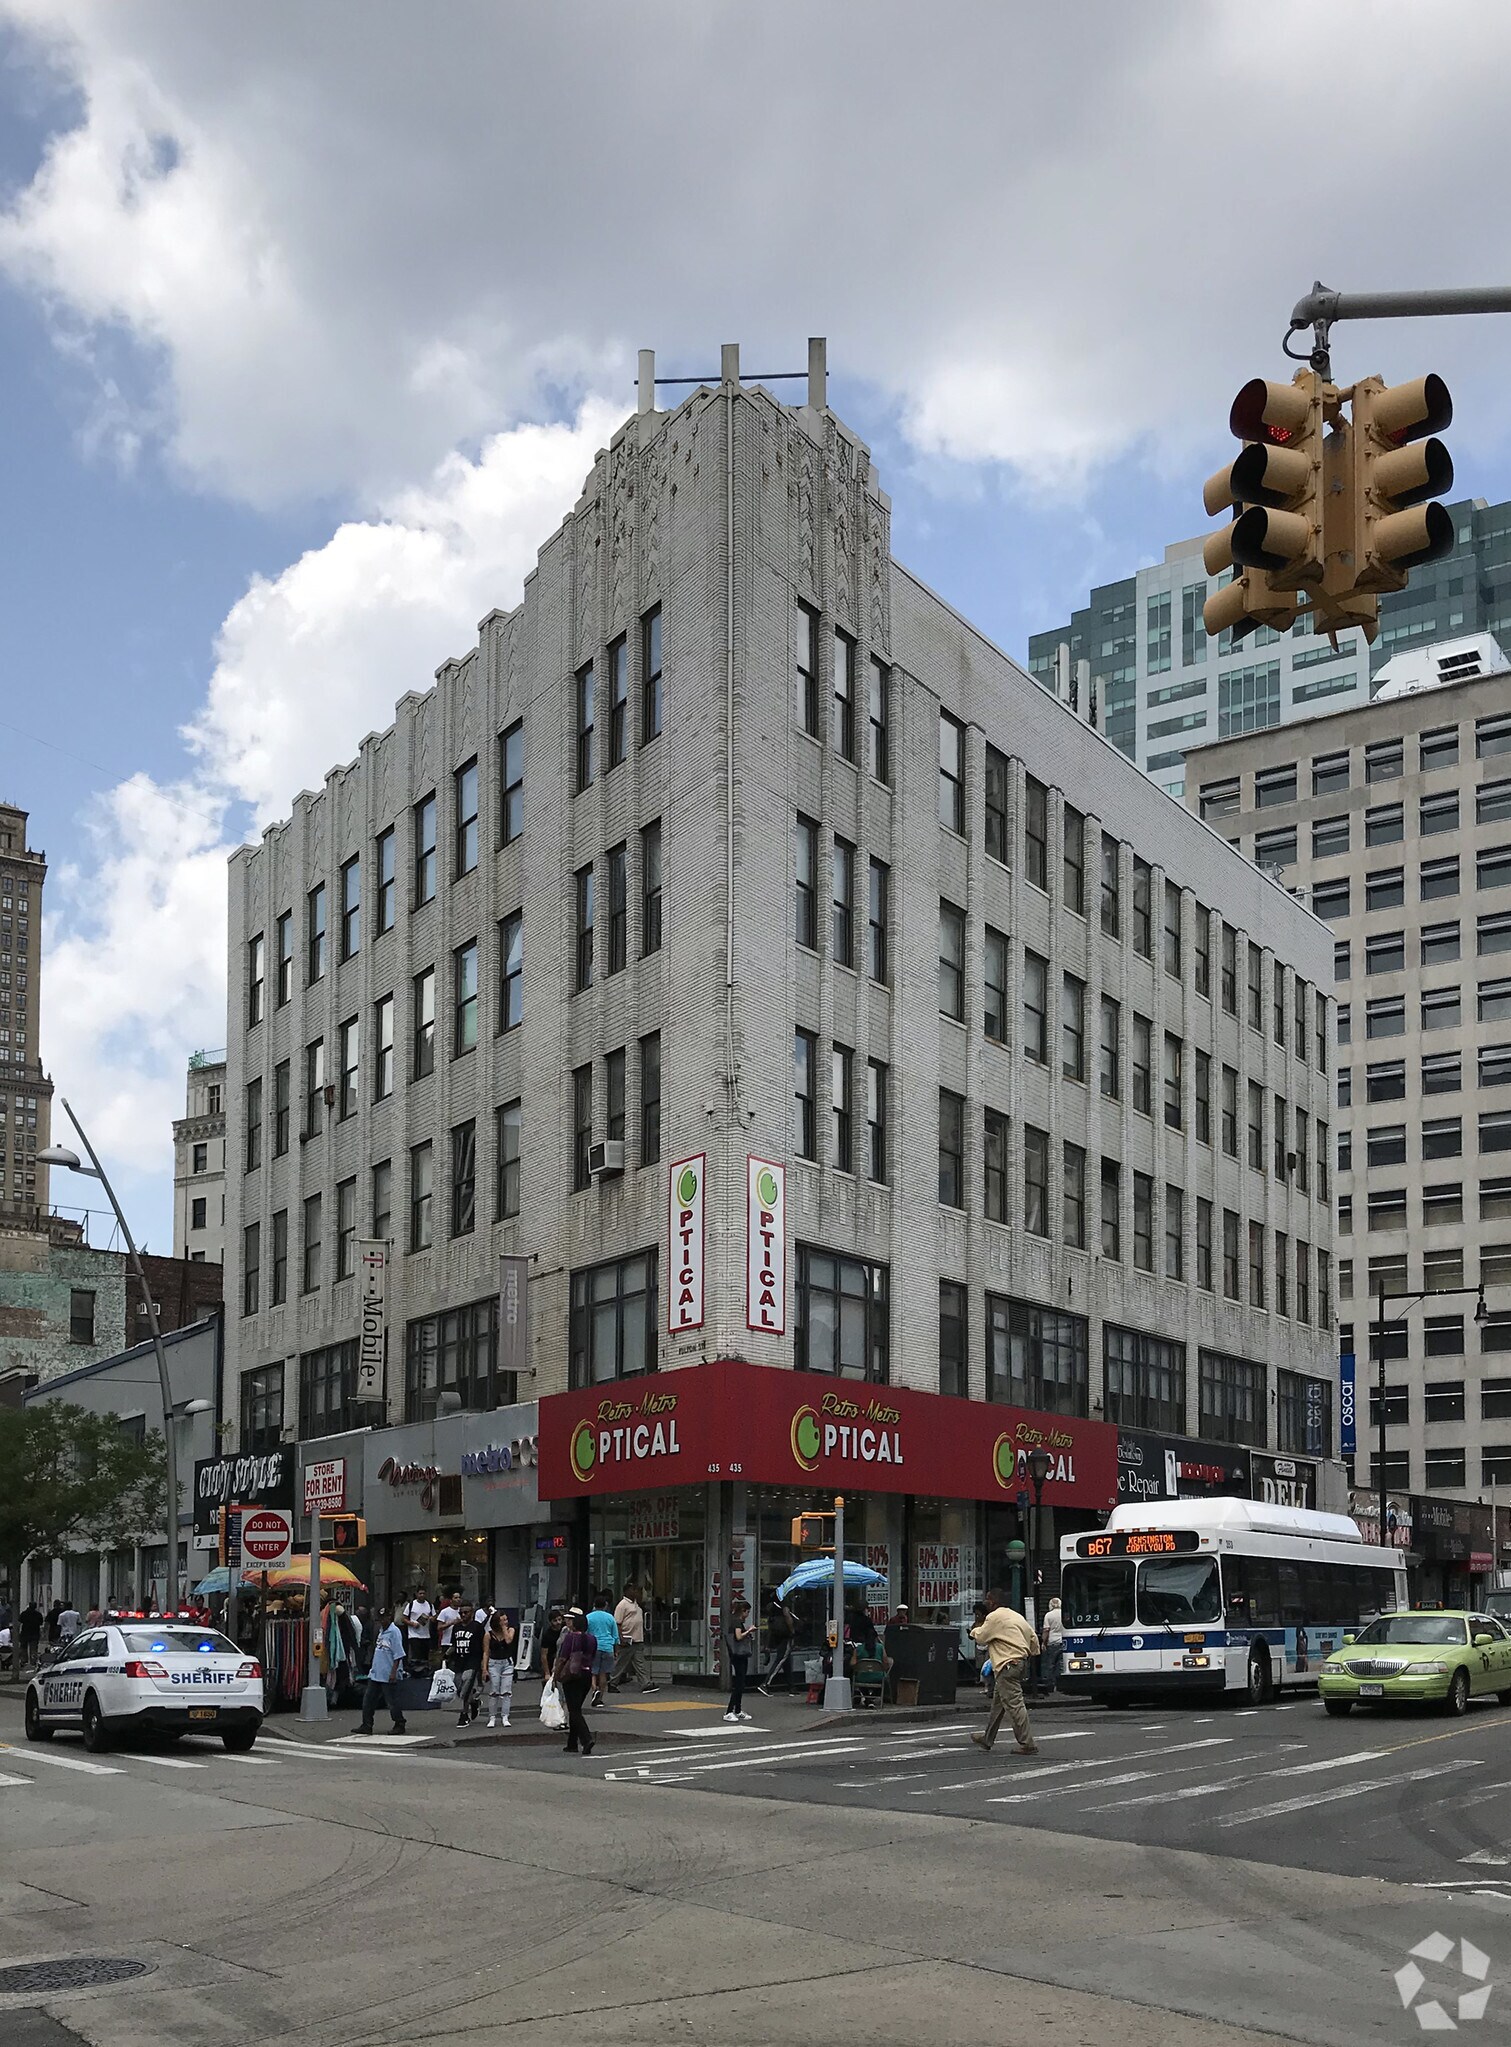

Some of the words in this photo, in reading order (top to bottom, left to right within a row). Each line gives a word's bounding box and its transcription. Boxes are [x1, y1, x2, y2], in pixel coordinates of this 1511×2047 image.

[597, 1399, 633, 1422] Retro
[640, 1391, 678, 1417] Metro
[821, 1391, 859, 1418] Retro
[865, 1398, 902, 1425] Metro
[1341, 1380, 1354, 1426] oscar
[1015, 1422, 1044, 1443] Retro
[1047, 1427, 1074, 1448] Metro
[313, 1463, 335, 1477] STORE
[707, 1463, 720, 1473] 435
[729, 1462, 742, 1473] 435
[306, 1479, 320, 1496] FOR
[322, 1475, 342, 1494] RENT
[1128, 1469, 1159, 1501] Repair
[252, 1521, 263, 1529] DO
[265, 1521, 281, 1529] NOT
[253, 1543, 280, 1552] ENTER
[1088, 1537, 1112, 1556] B67
[1128, 1534, 1173, 1545] KENSINGTON
[1165, 1541, 1176, 1551] RD
[867, 1544, 889, 1567] 50%
[919, 1546, 939, 1569] 50%
[941, 1547, 959, 1569] OFF
[921, 1571, 957, 1579] DESIGNER
[919, 1580, 959, 1603] FRAMES
[171, 1673, 235, 1685] SHERIFF
[49, 1681, 83, 1703] SHERIFF
